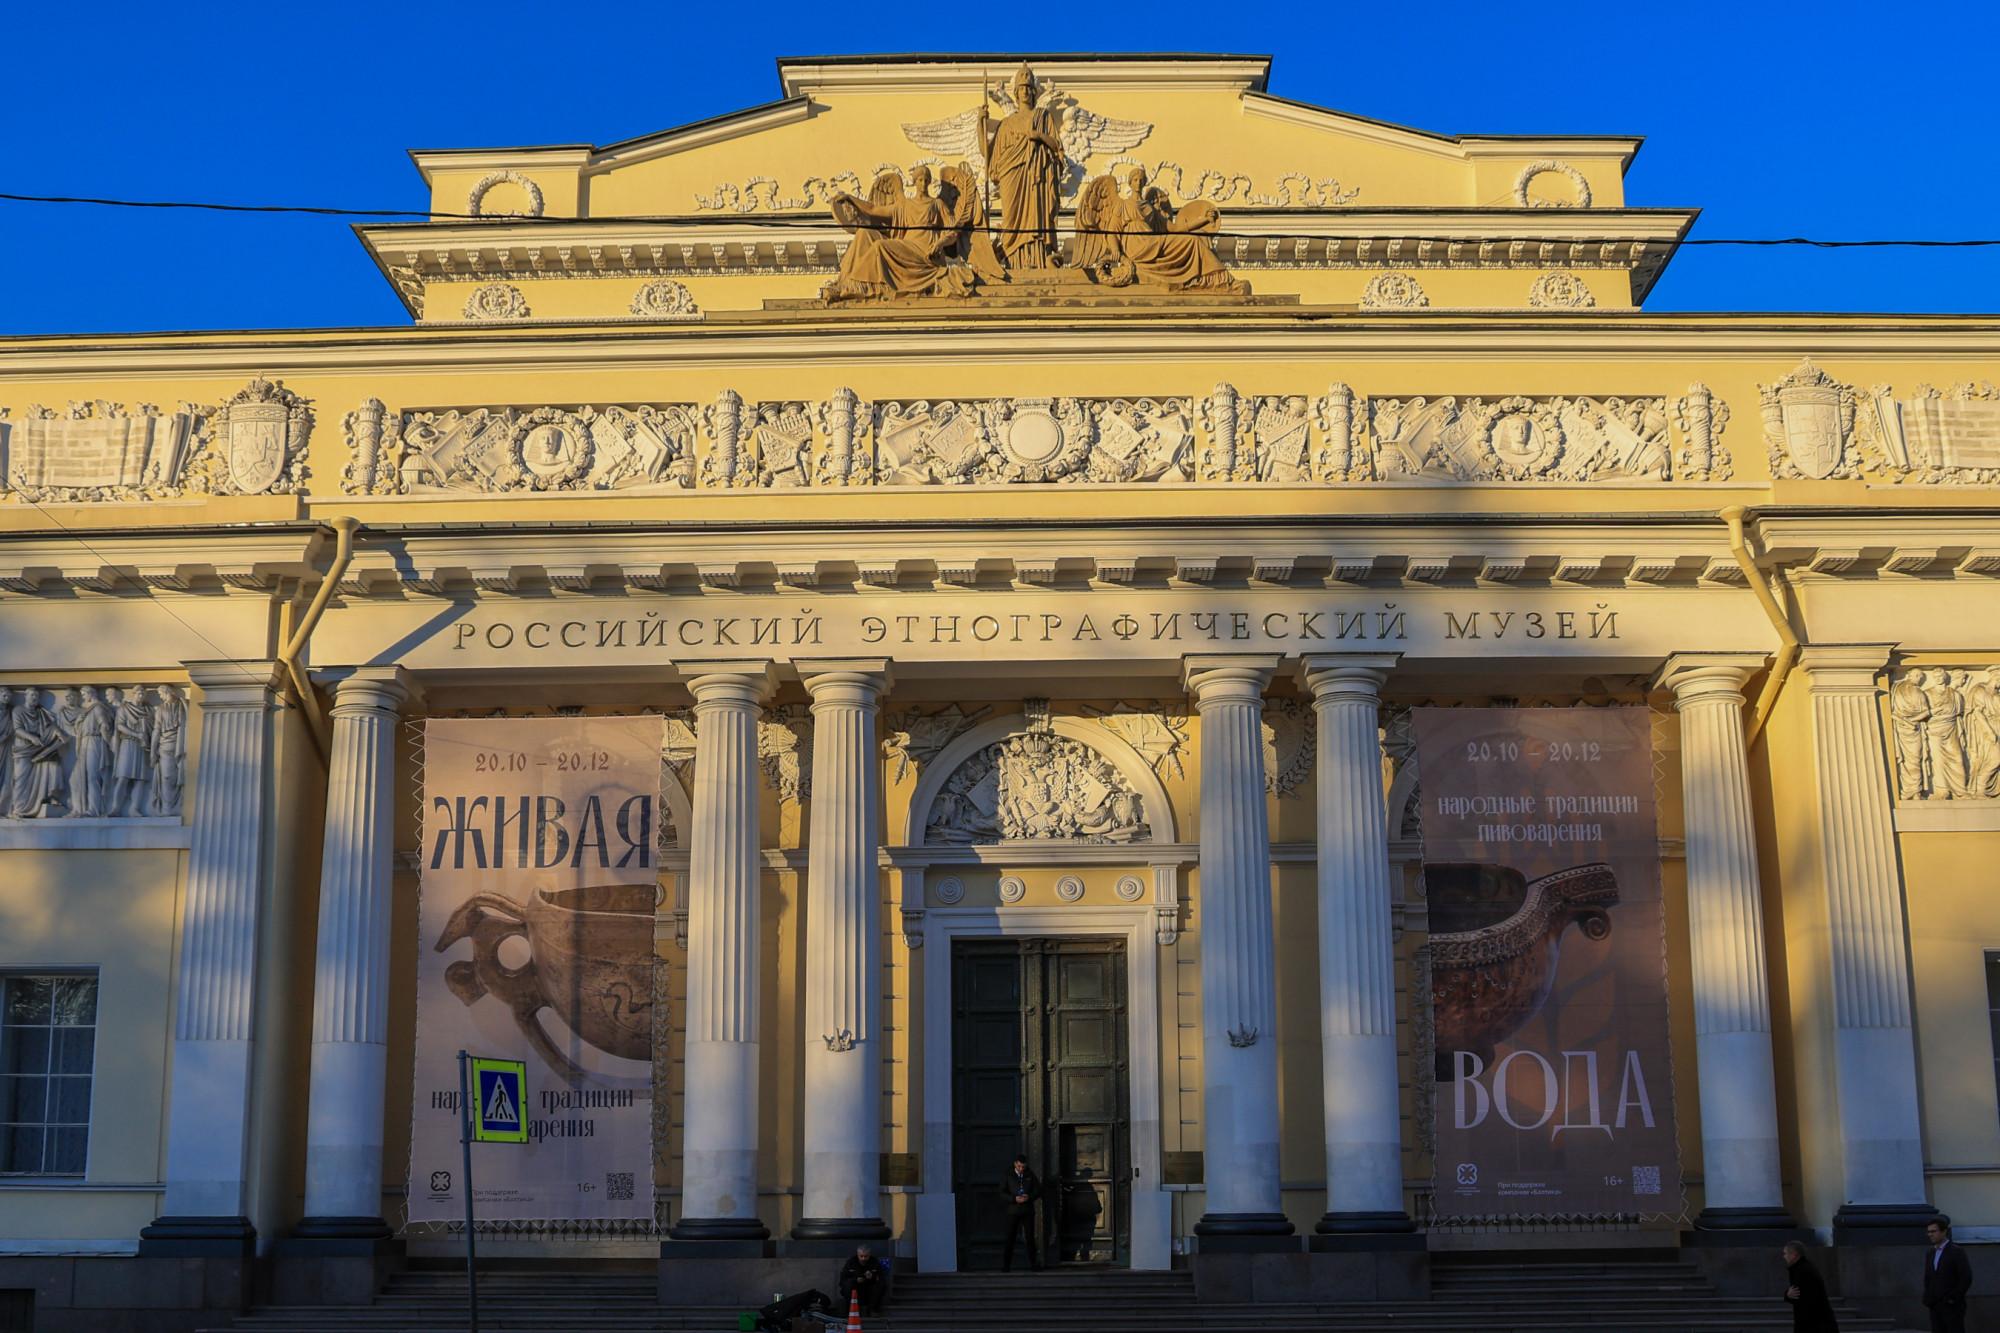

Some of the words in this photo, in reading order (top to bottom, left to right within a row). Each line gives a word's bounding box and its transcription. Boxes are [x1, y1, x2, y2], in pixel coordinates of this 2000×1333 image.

[452, 608, 823, 650] РОССИЙСКИЙ
[860, 603, 1408, 643] ЭТНОГРАФИЧЕСКИЙ
[1443, 602, 1621, 640] МУЗЕЙ
[475, 752, 527, 772] 20.10
[557, 751, 610, 771] 20.12
[1467, 742, 1519, 762] 20.10
[1550, 742, 1602, 762] 20.12
[1438, 796, 1537, 819] народные
[1546, 796, 1639, 819] традиции
[430, 795, 652, 869] ЖИВАЯ
[1478, 823, 1602, 847] пивоварения
[539, 1089, 634, 1114] традиции
[1453, 1050, 1656, 1141] ВОДА
[577, 1183, 597, 1193] 16+
[1603, 1175, 1624, 1187] 16+
